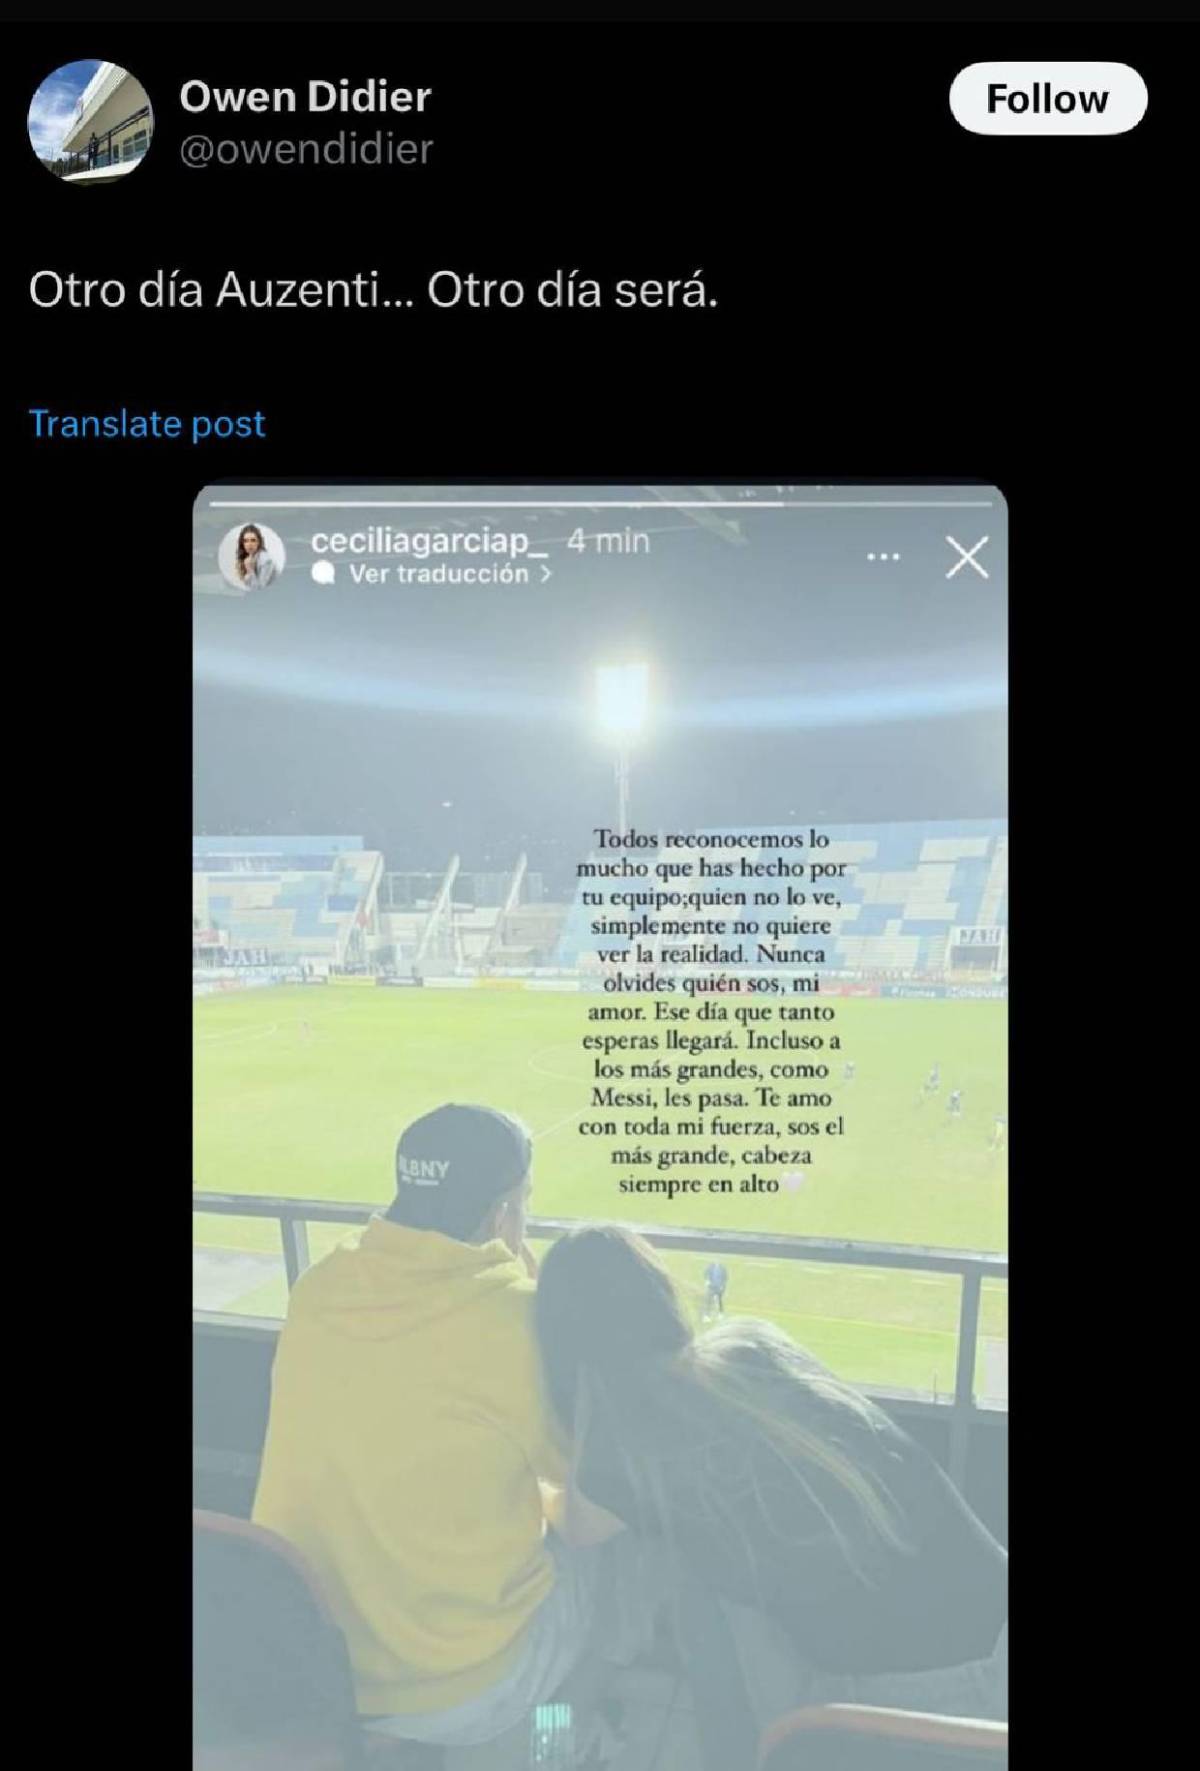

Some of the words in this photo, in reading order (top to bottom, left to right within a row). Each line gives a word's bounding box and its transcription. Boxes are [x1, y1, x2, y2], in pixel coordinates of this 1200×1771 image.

[180, 79, 296, 113] Owen
[308, 78, 433, 113] Didier
[987, 82, 1110, 114] Follow
[180, 130, 434, 169] @owendidier
[29, 270, 126, 308] Otro
[139, 269, 203, 308] día
[215, 270, 414, 308] Auzenti...
[427, 270, 525, 308] Otro
[537, 269, 601, 308] día
[614, 269, 718, 308] será.
[28, 407, 182, 438] Translate
[192, 411, 266, 445] post
[311, 525, 549, 560] ceciliagarciap_
[567, 527, 586, 553] 4
[596, 526, 650, 553] min
[349, 563, 390, 584] Ver
[396, 562, 529, 584] traducción
